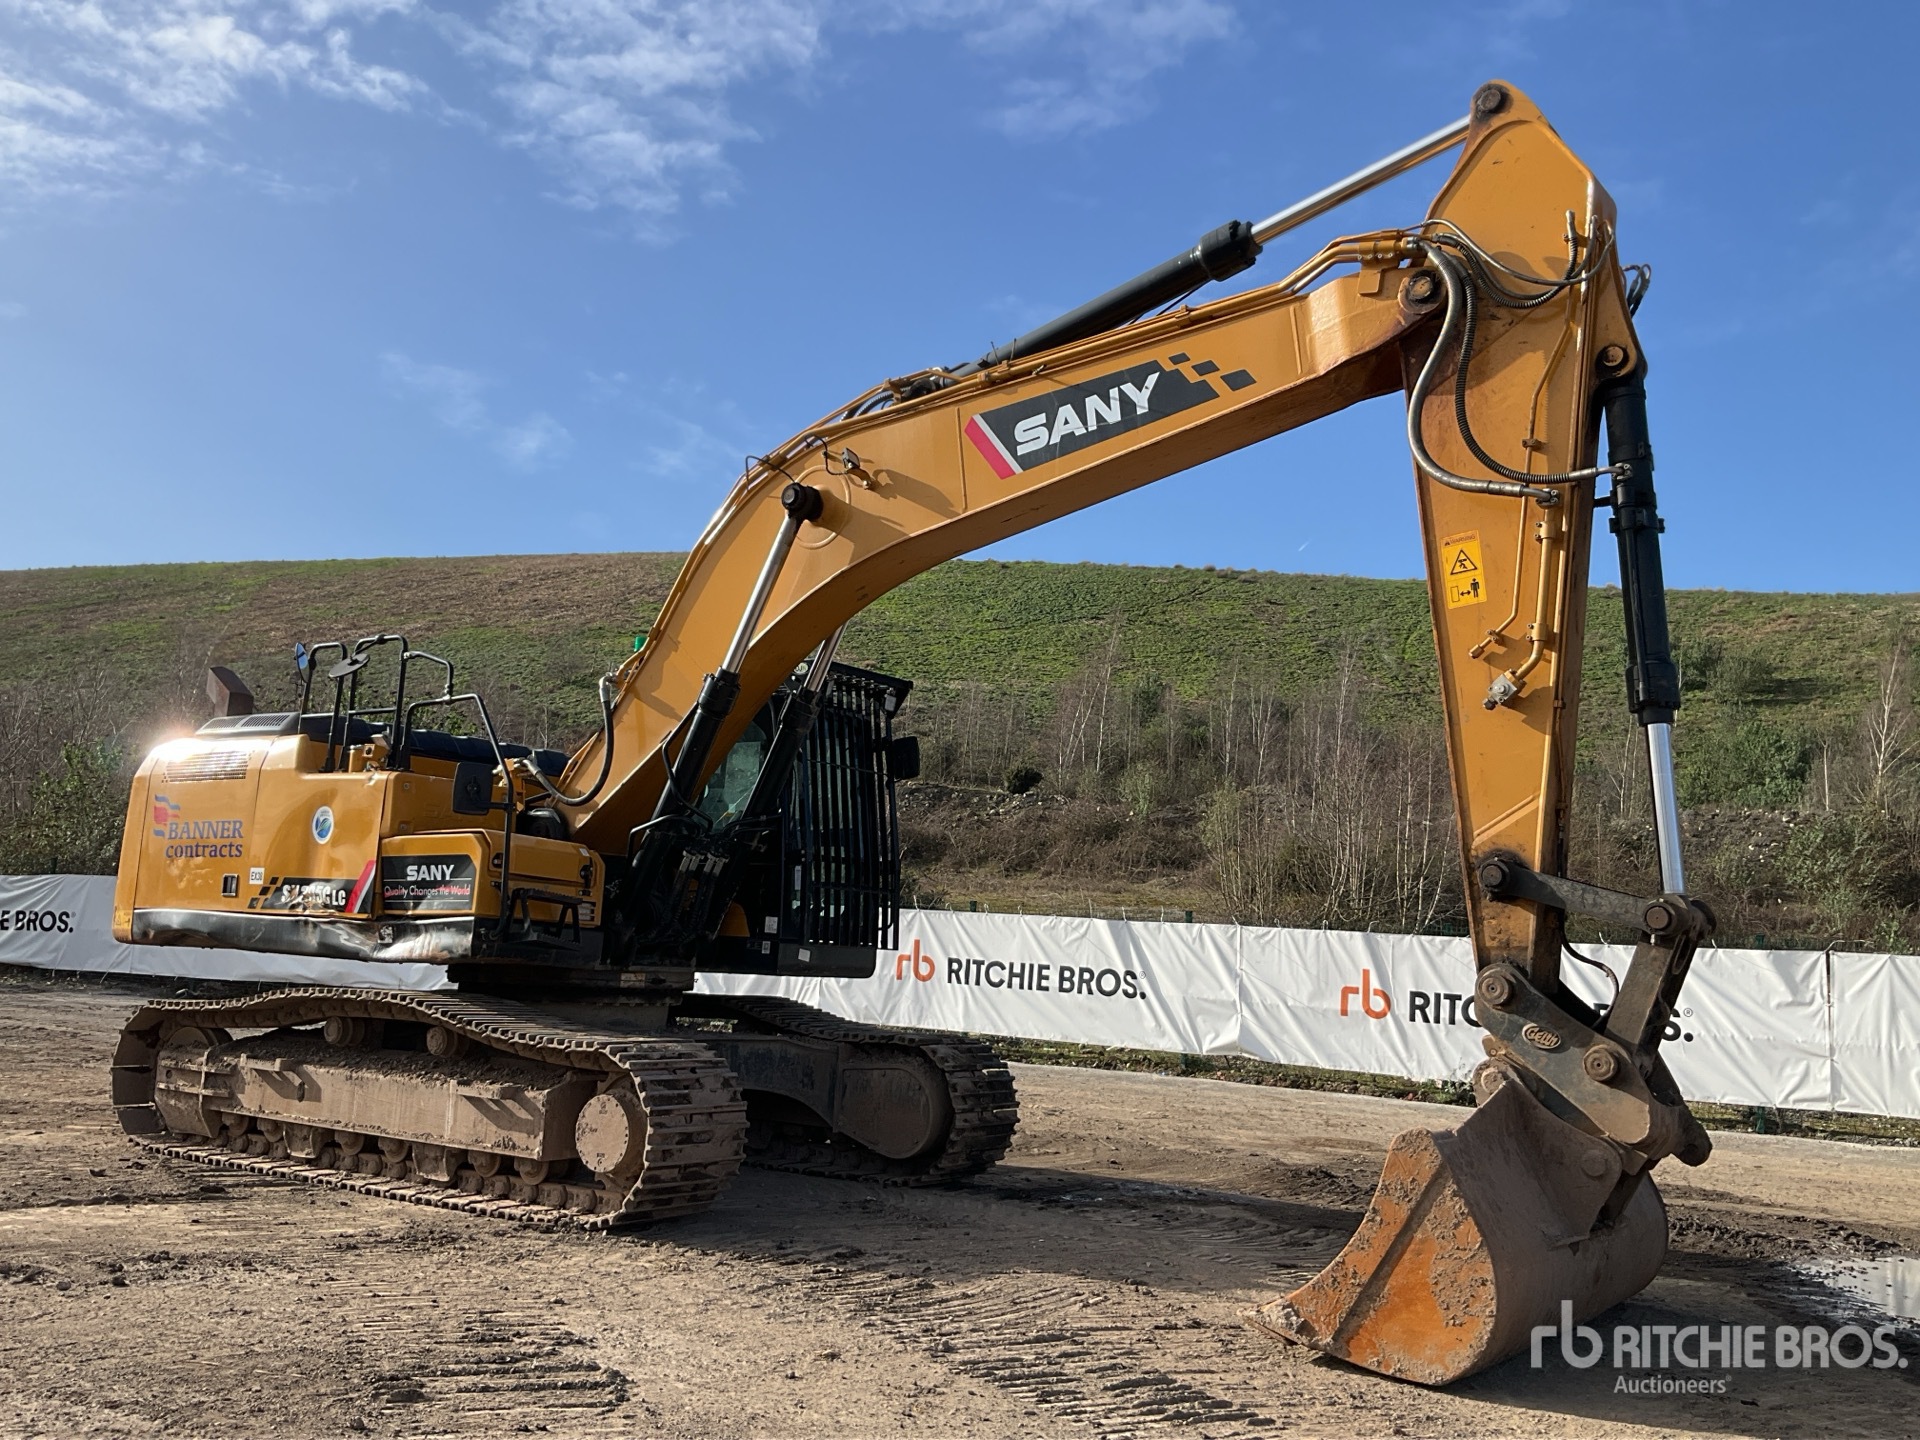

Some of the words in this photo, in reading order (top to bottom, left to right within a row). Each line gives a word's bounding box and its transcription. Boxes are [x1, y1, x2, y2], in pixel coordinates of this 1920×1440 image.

[1013, 372, 1160, 456] SANY
[167, 820, 244, 840] BANNER
[165, 841, 243, 858] contracts
[406, 864, 455, 881] SANY
[384, 885, 408, 898] Quality
[409, 884, 438, 898] Changes
[439, 884, 449, 896] the
[450, 883, 471, 896] World
[896, 939, 936, 982] rb
[947, 957, 1050, 992] RITCHIE
[1340, 968, 1392, 1019] rb
[1409, 990, 1483, 1028] RITC
